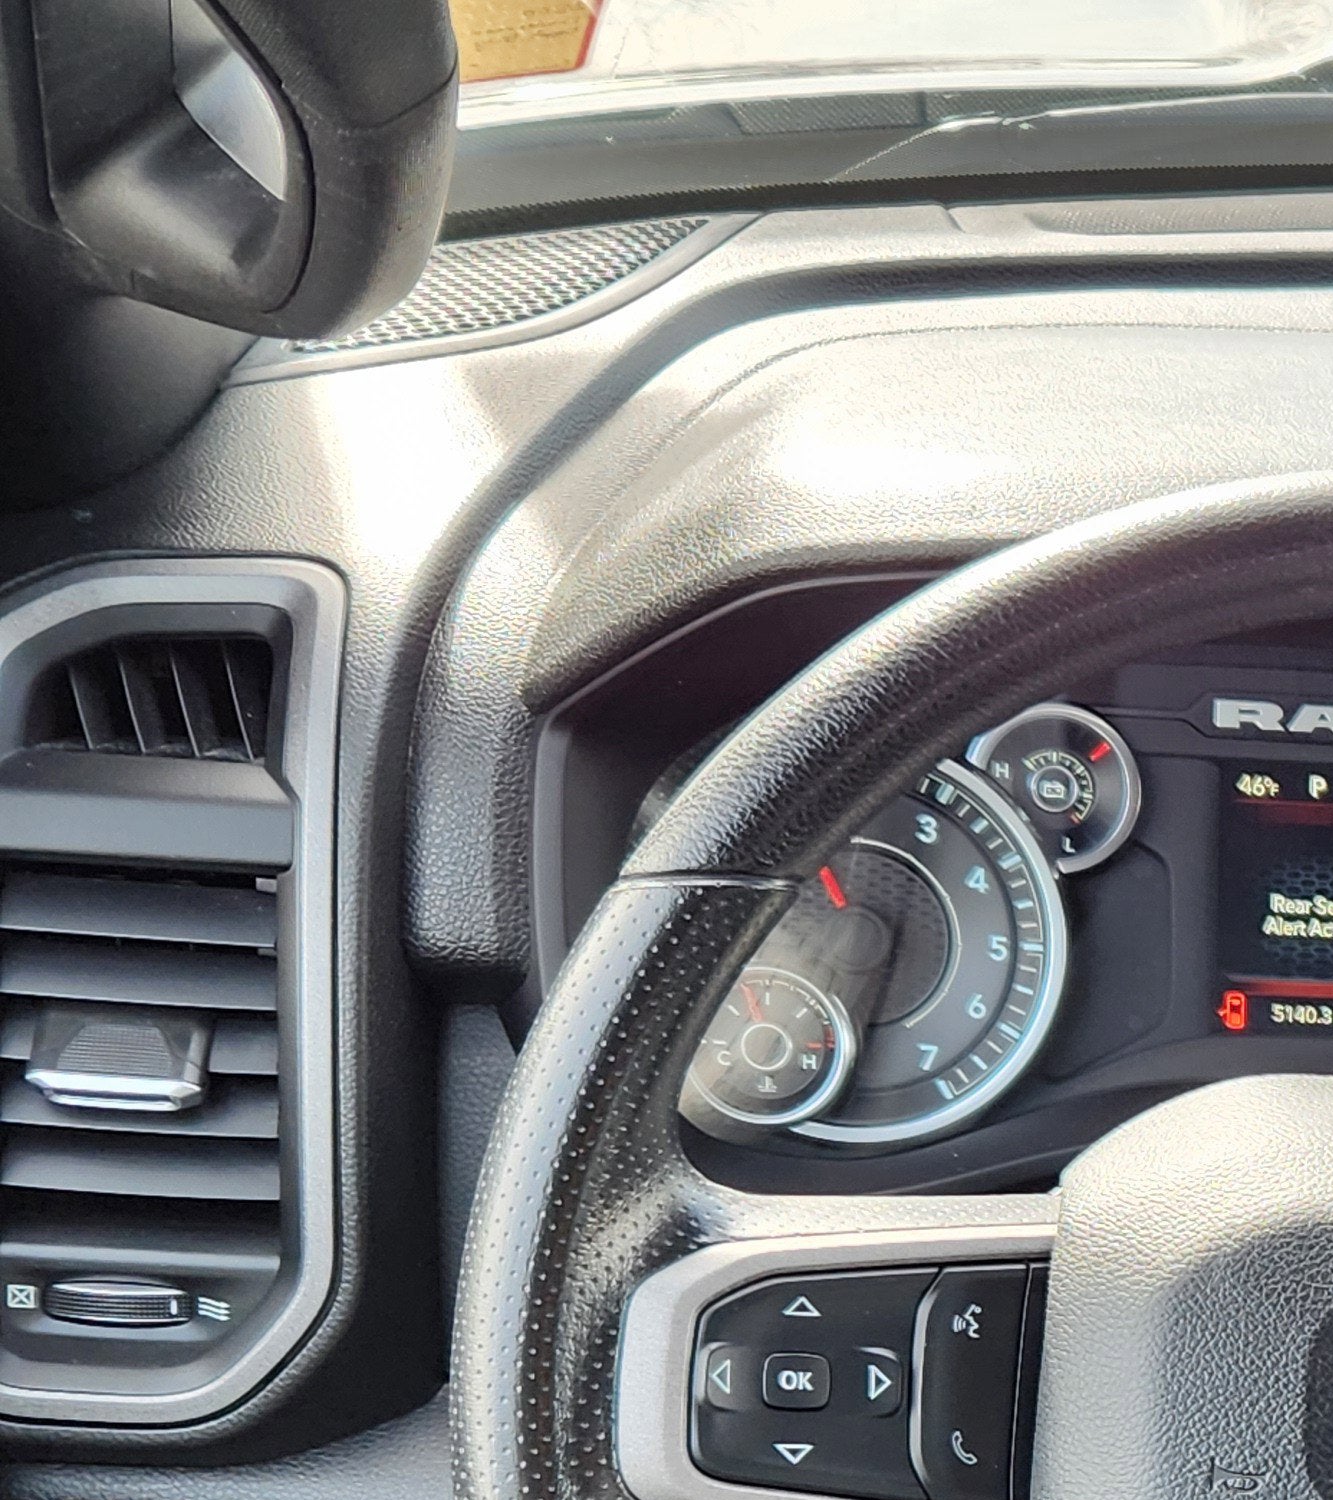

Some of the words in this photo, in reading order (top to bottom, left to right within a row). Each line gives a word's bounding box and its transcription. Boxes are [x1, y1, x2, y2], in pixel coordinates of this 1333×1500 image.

[1309, 775, 1328, 799] P
[915, 815, 939, 845] 3
[965, 867, 989, 893] 4
[1269, 894, 1312, 915] Rear
[1263, 916, 1307, 937] Alert
[989, 937, 1008, 961] 5
[967, 996, 986, 1019] 6
[1271, 1005, 1333, 1026] 5140.3
[716, 1050, 731, 1066] C
[801, 1053, 817, 1070] H
[918, 1044, 939, 1071] 7
[777, 1369, 814, 1391] OK
